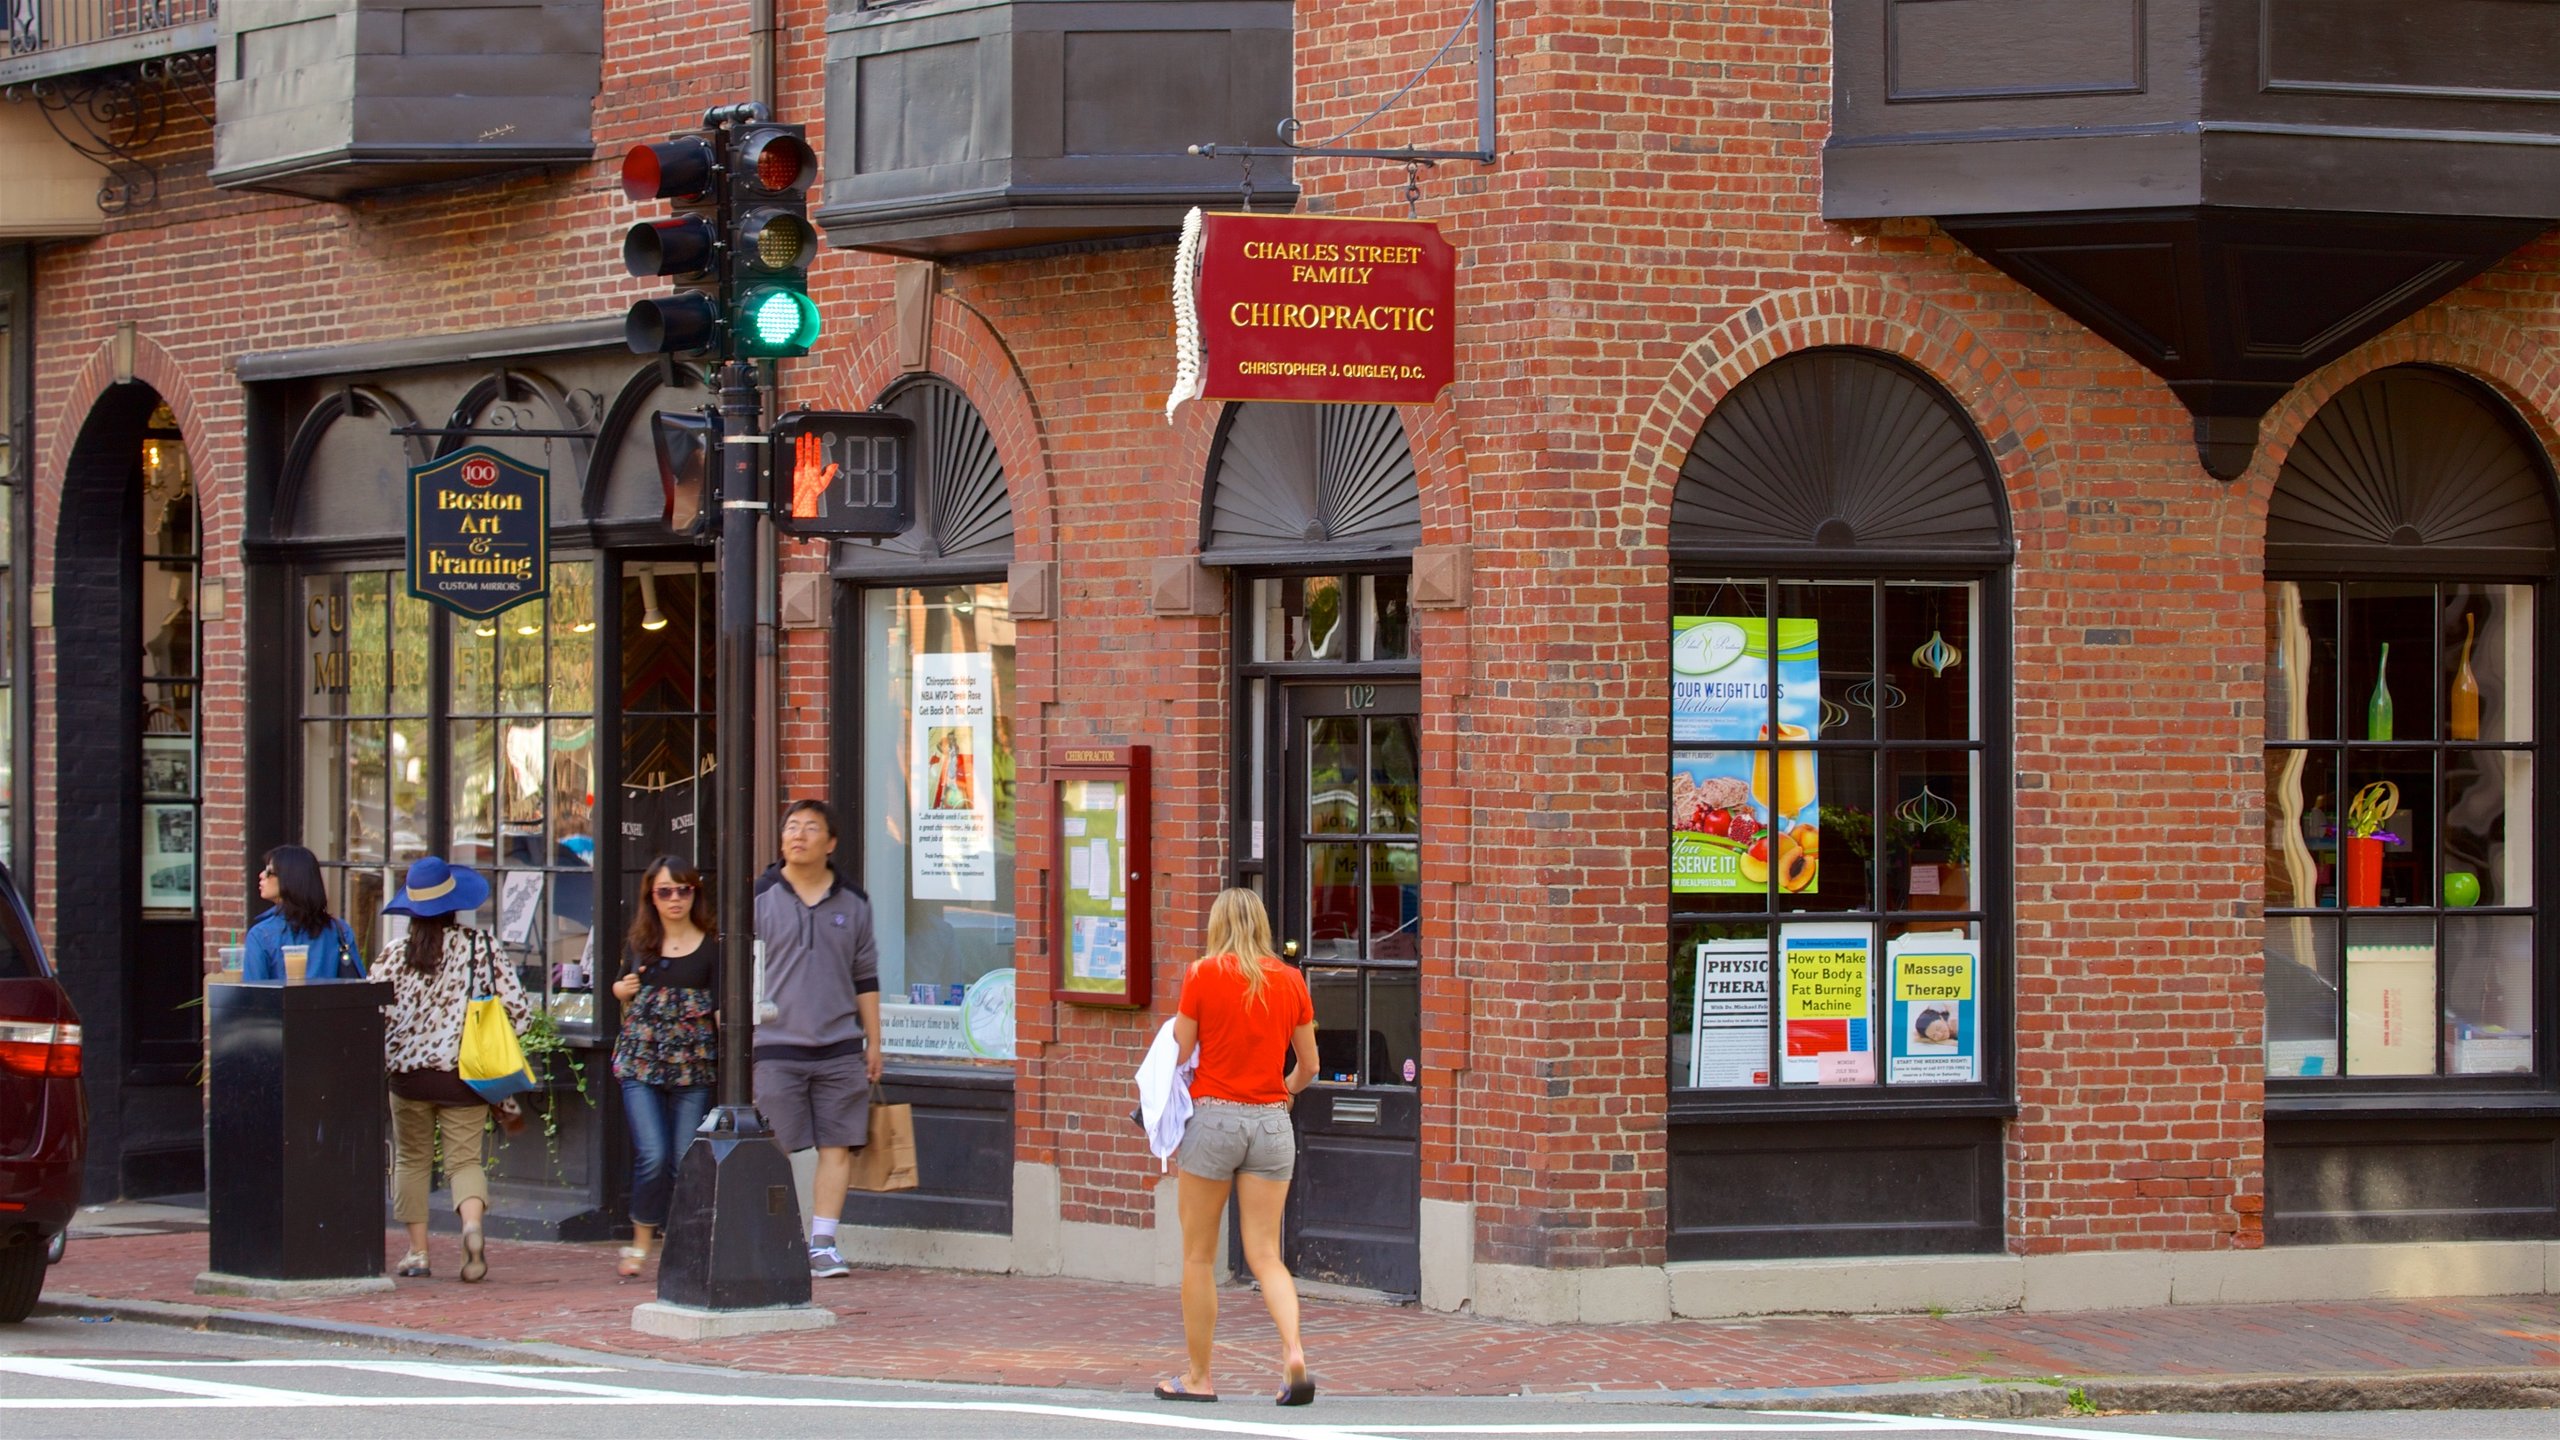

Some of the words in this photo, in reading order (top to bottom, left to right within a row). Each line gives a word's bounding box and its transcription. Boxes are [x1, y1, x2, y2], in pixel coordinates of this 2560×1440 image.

[1243, 241, 1339, 263] CHARLES
[1344, 245, 1422, 264] STREET
[1292, 265, 1373, 284] FAMILY
[1230, 302, 1434, 332] CHIROPRACTIC
[1239, 361, 1327, 377] CHRISTOPHER
[1329, 364, 1340, 377] J.
[1343, 364, 1398, 380] QUIGLEY,
[1401, 366, 1426, 379] D.C.
[466, 466, 496, 481] 100
[438, 489, 522, 510] Boston
[459, 512, 502, 534] Art
[469, 537, 492, 555] &
[428, 550, 533, 580] Framing
[438, 581, 478, 591] CUSTOM
[480, 581, 521, 591] MIRRORS
[921, 690, 934, 700] NBA
[935, 690, 949, 700] MVP
[1344, 685, 1375, 709] 102
[1705, 682, 1750, 698] WEIGHT
[1754, 684, 1784, 699] LOS
[919, 705, 929, 715] Get
[930, 705, 944, 715] Back
[1065, 750, 1115, 761] CHIROPRACTOR
[1720, 856, 1737, 873] IT!
[1787, 953, 1815, 964] How
[1819, 954, 1831, 964] to
[1835, 952, 1866, 964] Make
[1791, 968, 1818, 979] Your
[1822, 968, 1852, 982] Body
[1856, 971, 1863, 979] a
[1904, 963, 1963, 977] Massage
[1792, 984, 1811, 995] Fat
[1815, 984, 1862, 998] Burning
[1906, 984, 1961, 998] Therapy
[1802, 999, 1851, 1010] Machine
[891, 1016, 909, 1028] don't
[910, 1016, 926, 1029] have
[927, 1017, 942, 1030] time
[943, 1020, 950, 1029] to
[951, 1018, 960, 1030] be
[888, 1037, 904, 1046] must
[905, 1036, 923, 1048] make
[925, 1036, 940, 1048] time
[948, 1037, 956, 1049] be
